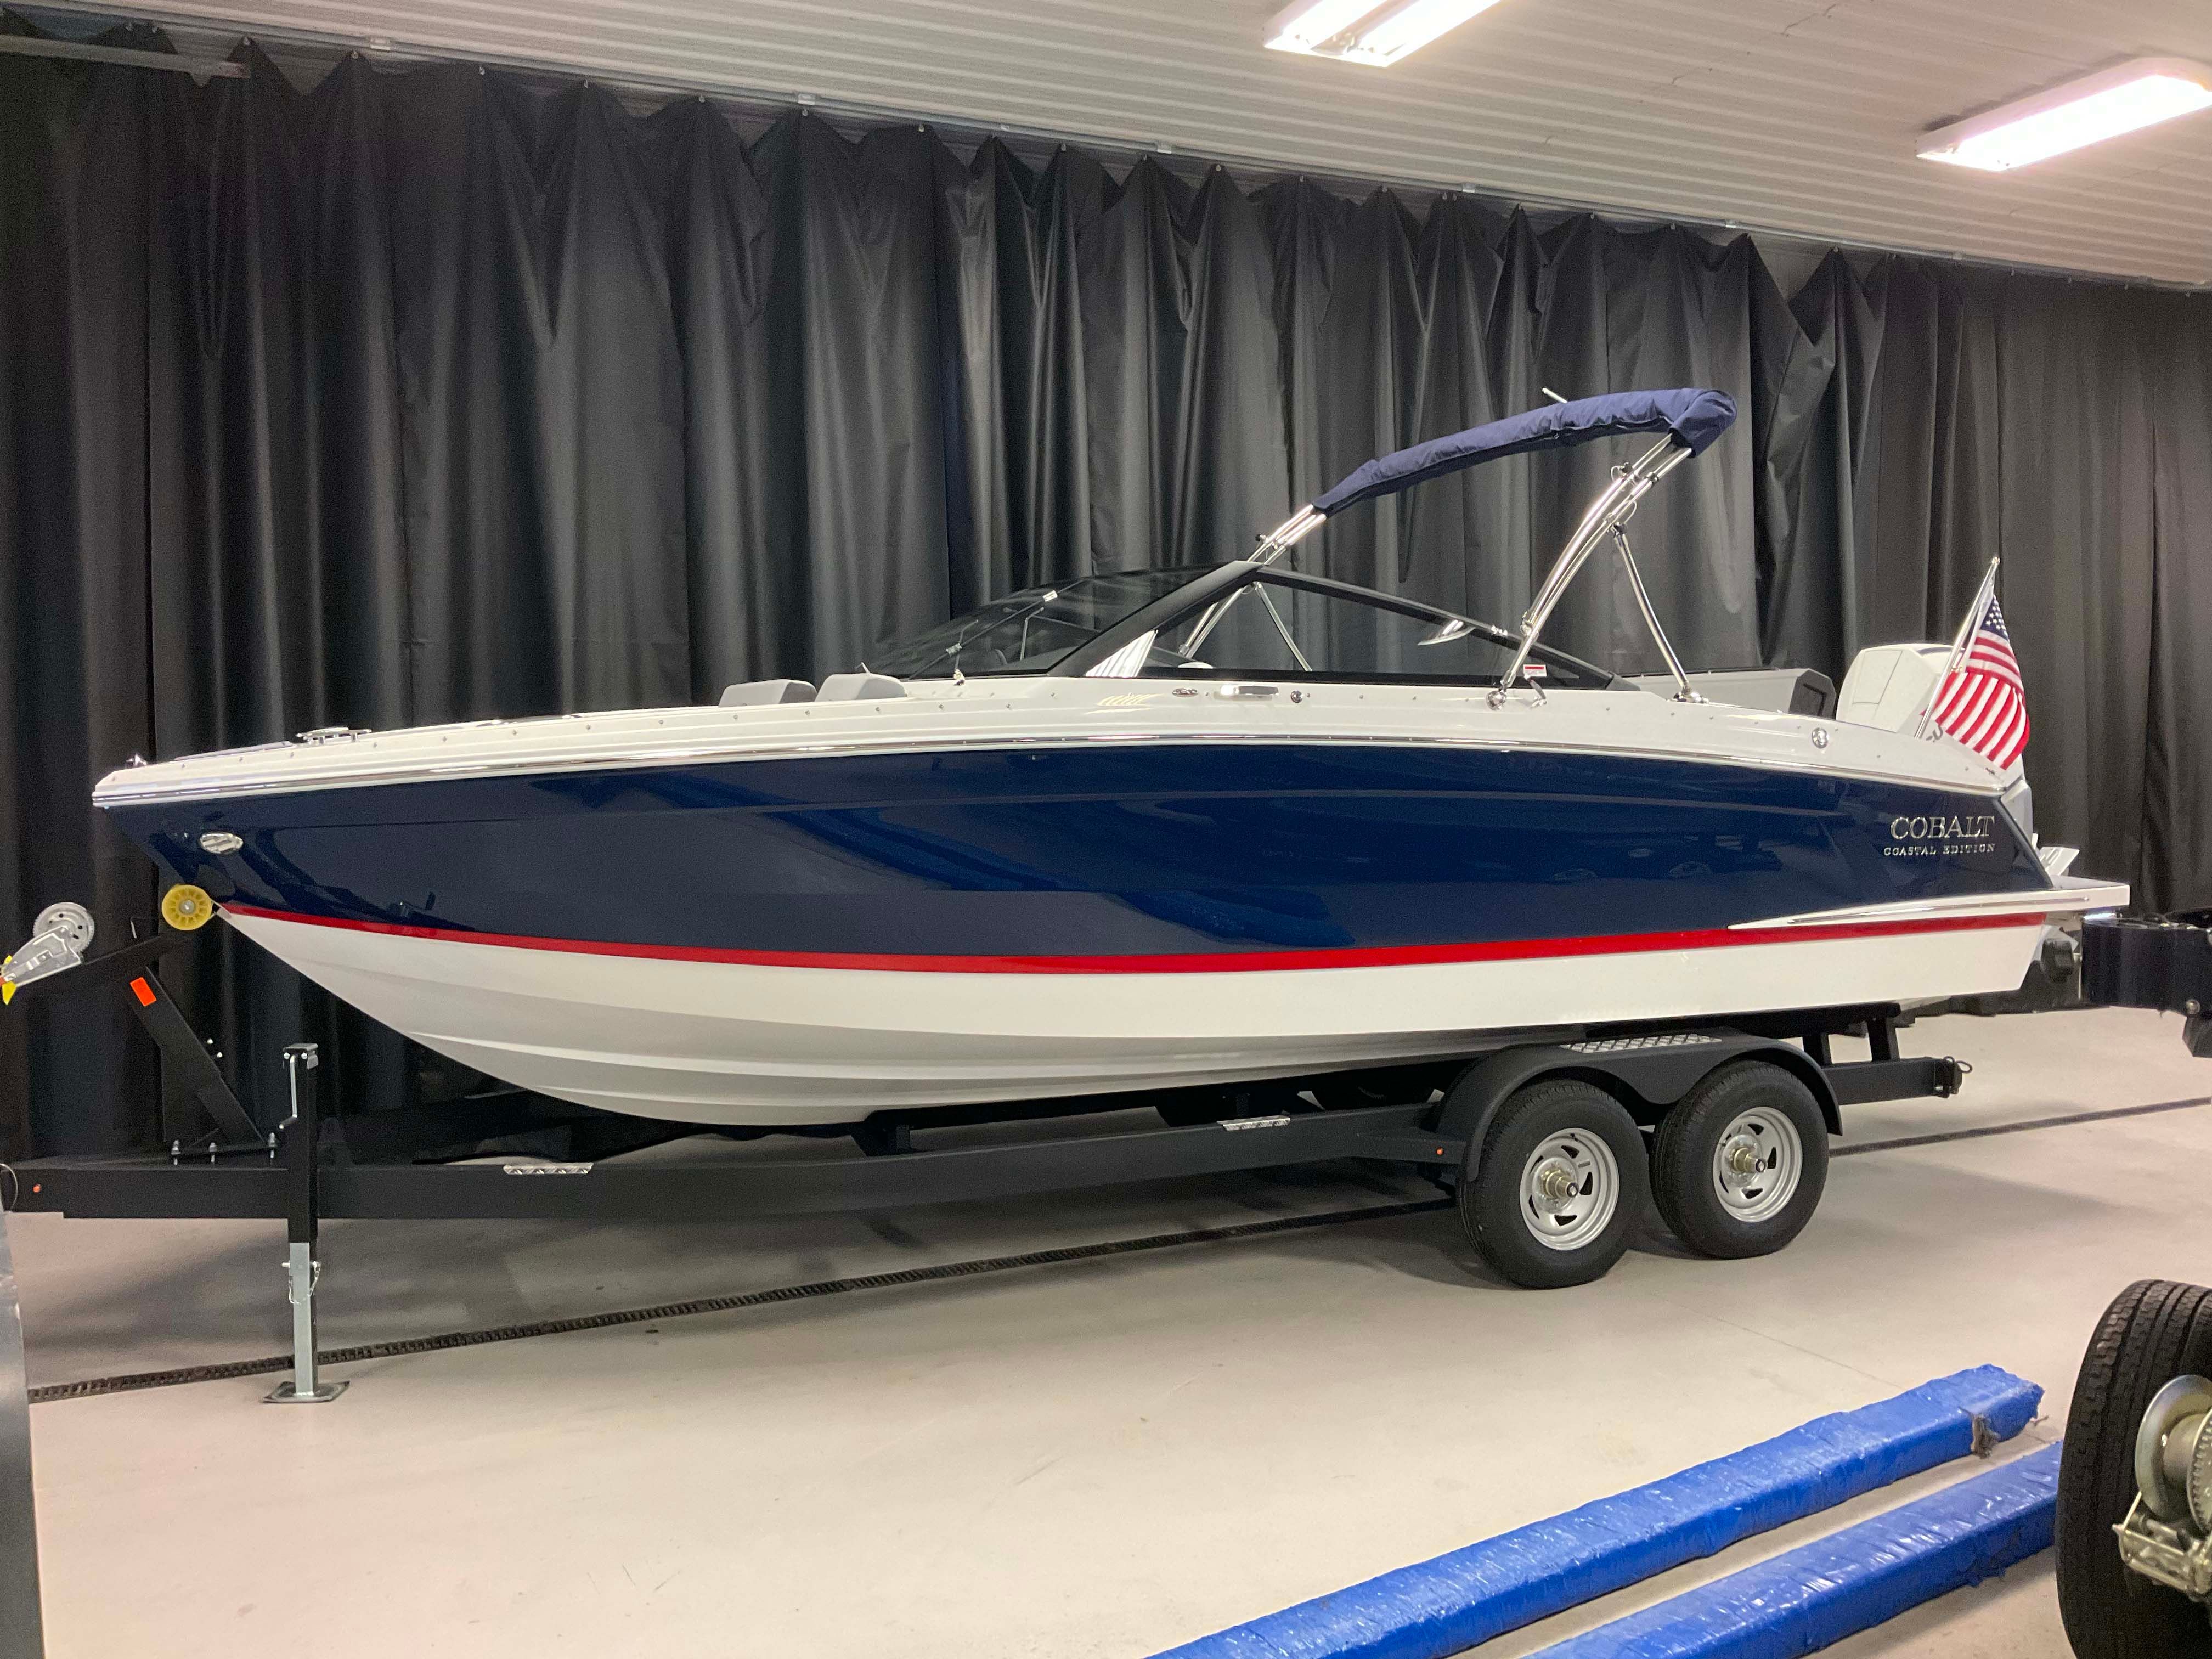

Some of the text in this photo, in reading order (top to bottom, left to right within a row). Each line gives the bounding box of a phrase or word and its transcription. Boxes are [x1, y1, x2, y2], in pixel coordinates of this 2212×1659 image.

[1891, 816, 1995, 839] COBALT
[1883, 843, 1996, 856] COASTAL EDITION
